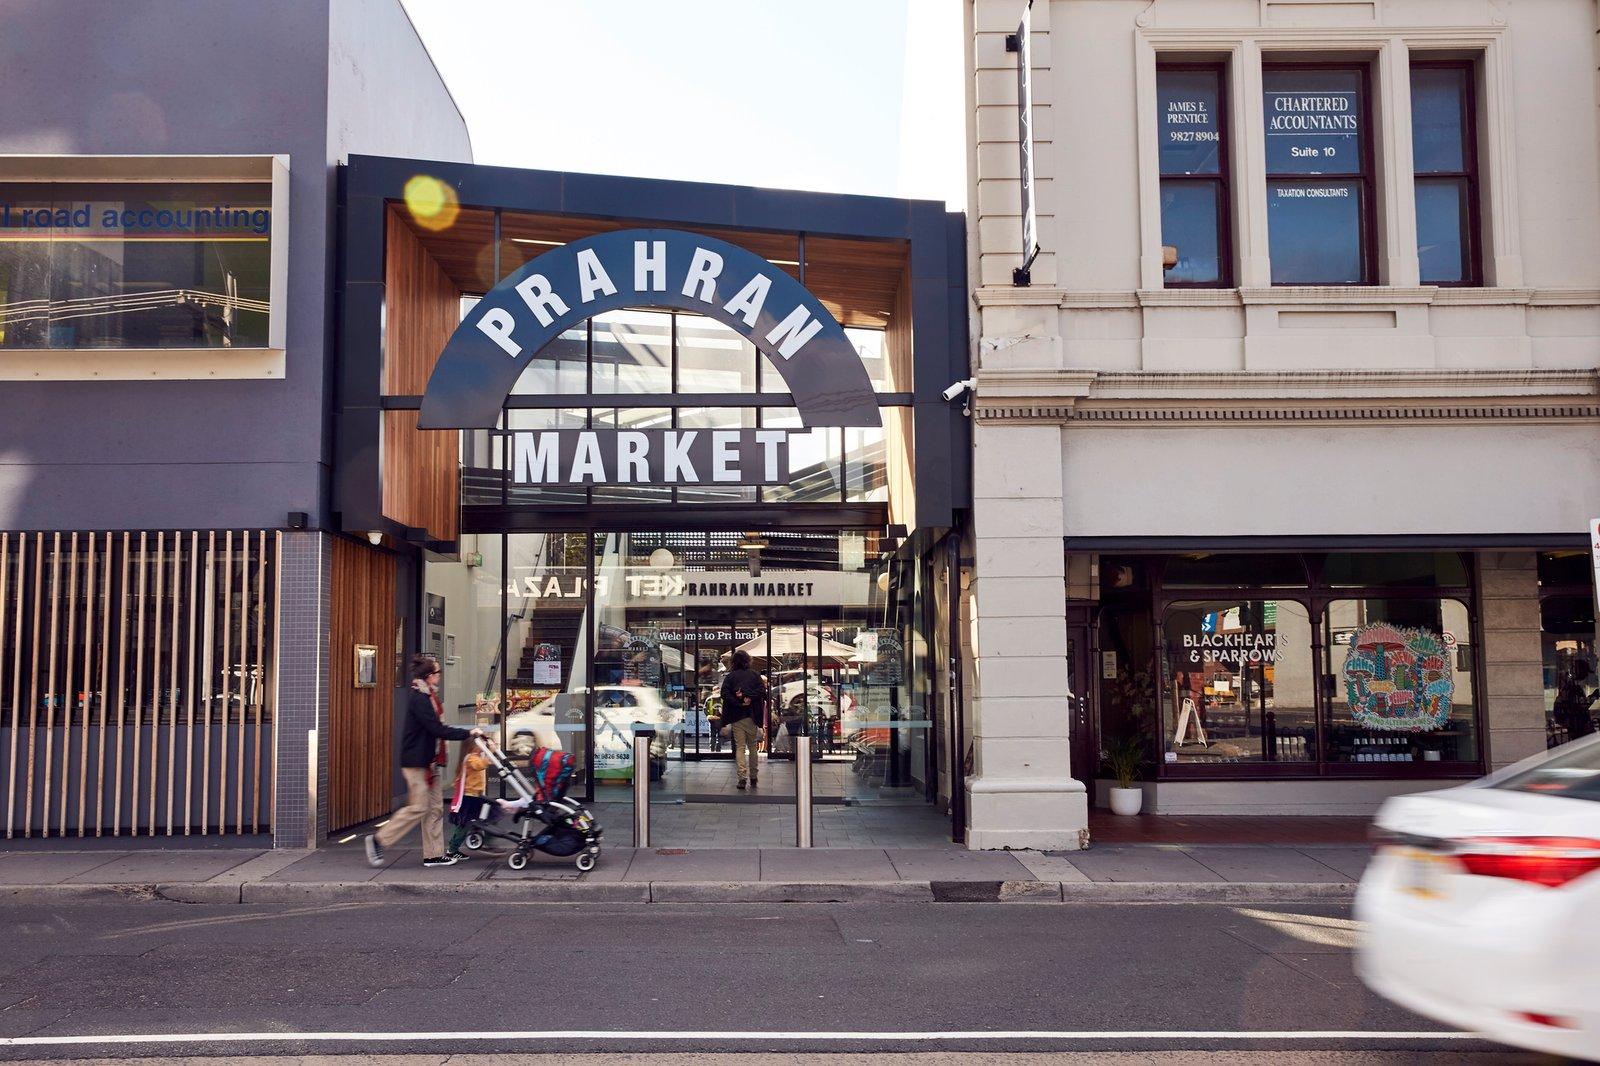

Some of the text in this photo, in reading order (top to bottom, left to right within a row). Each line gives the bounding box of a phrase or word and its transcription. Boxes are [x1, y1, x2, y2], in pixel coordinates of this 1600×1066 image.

[1167, 101, 1207, 112] JAMES E.
[1274, 97, 1349, 112] CHARTERED
[1166, 113, 1209, 124] PRENTICE
[1269, 115, 1357, 131] ACCOUNTANTS
[1291, 146, 1336, 158] Suite 10
[1276, 188, 1349, 198] TAXATION CONSULTANTS
[21, 203, 91, 229] road
[102, 203, 270, 234] accounting
[475, 239, 824, 361] PRAHRAN
[513, 430, 787, 484] MARKET
[753, 582, 814, 597] MARKET
[704, 632, 715, 642] to
[1182, 633, 1289, 648] BLACKHEARTS
[1189, 649, 1284, 664] & SPARROWS
